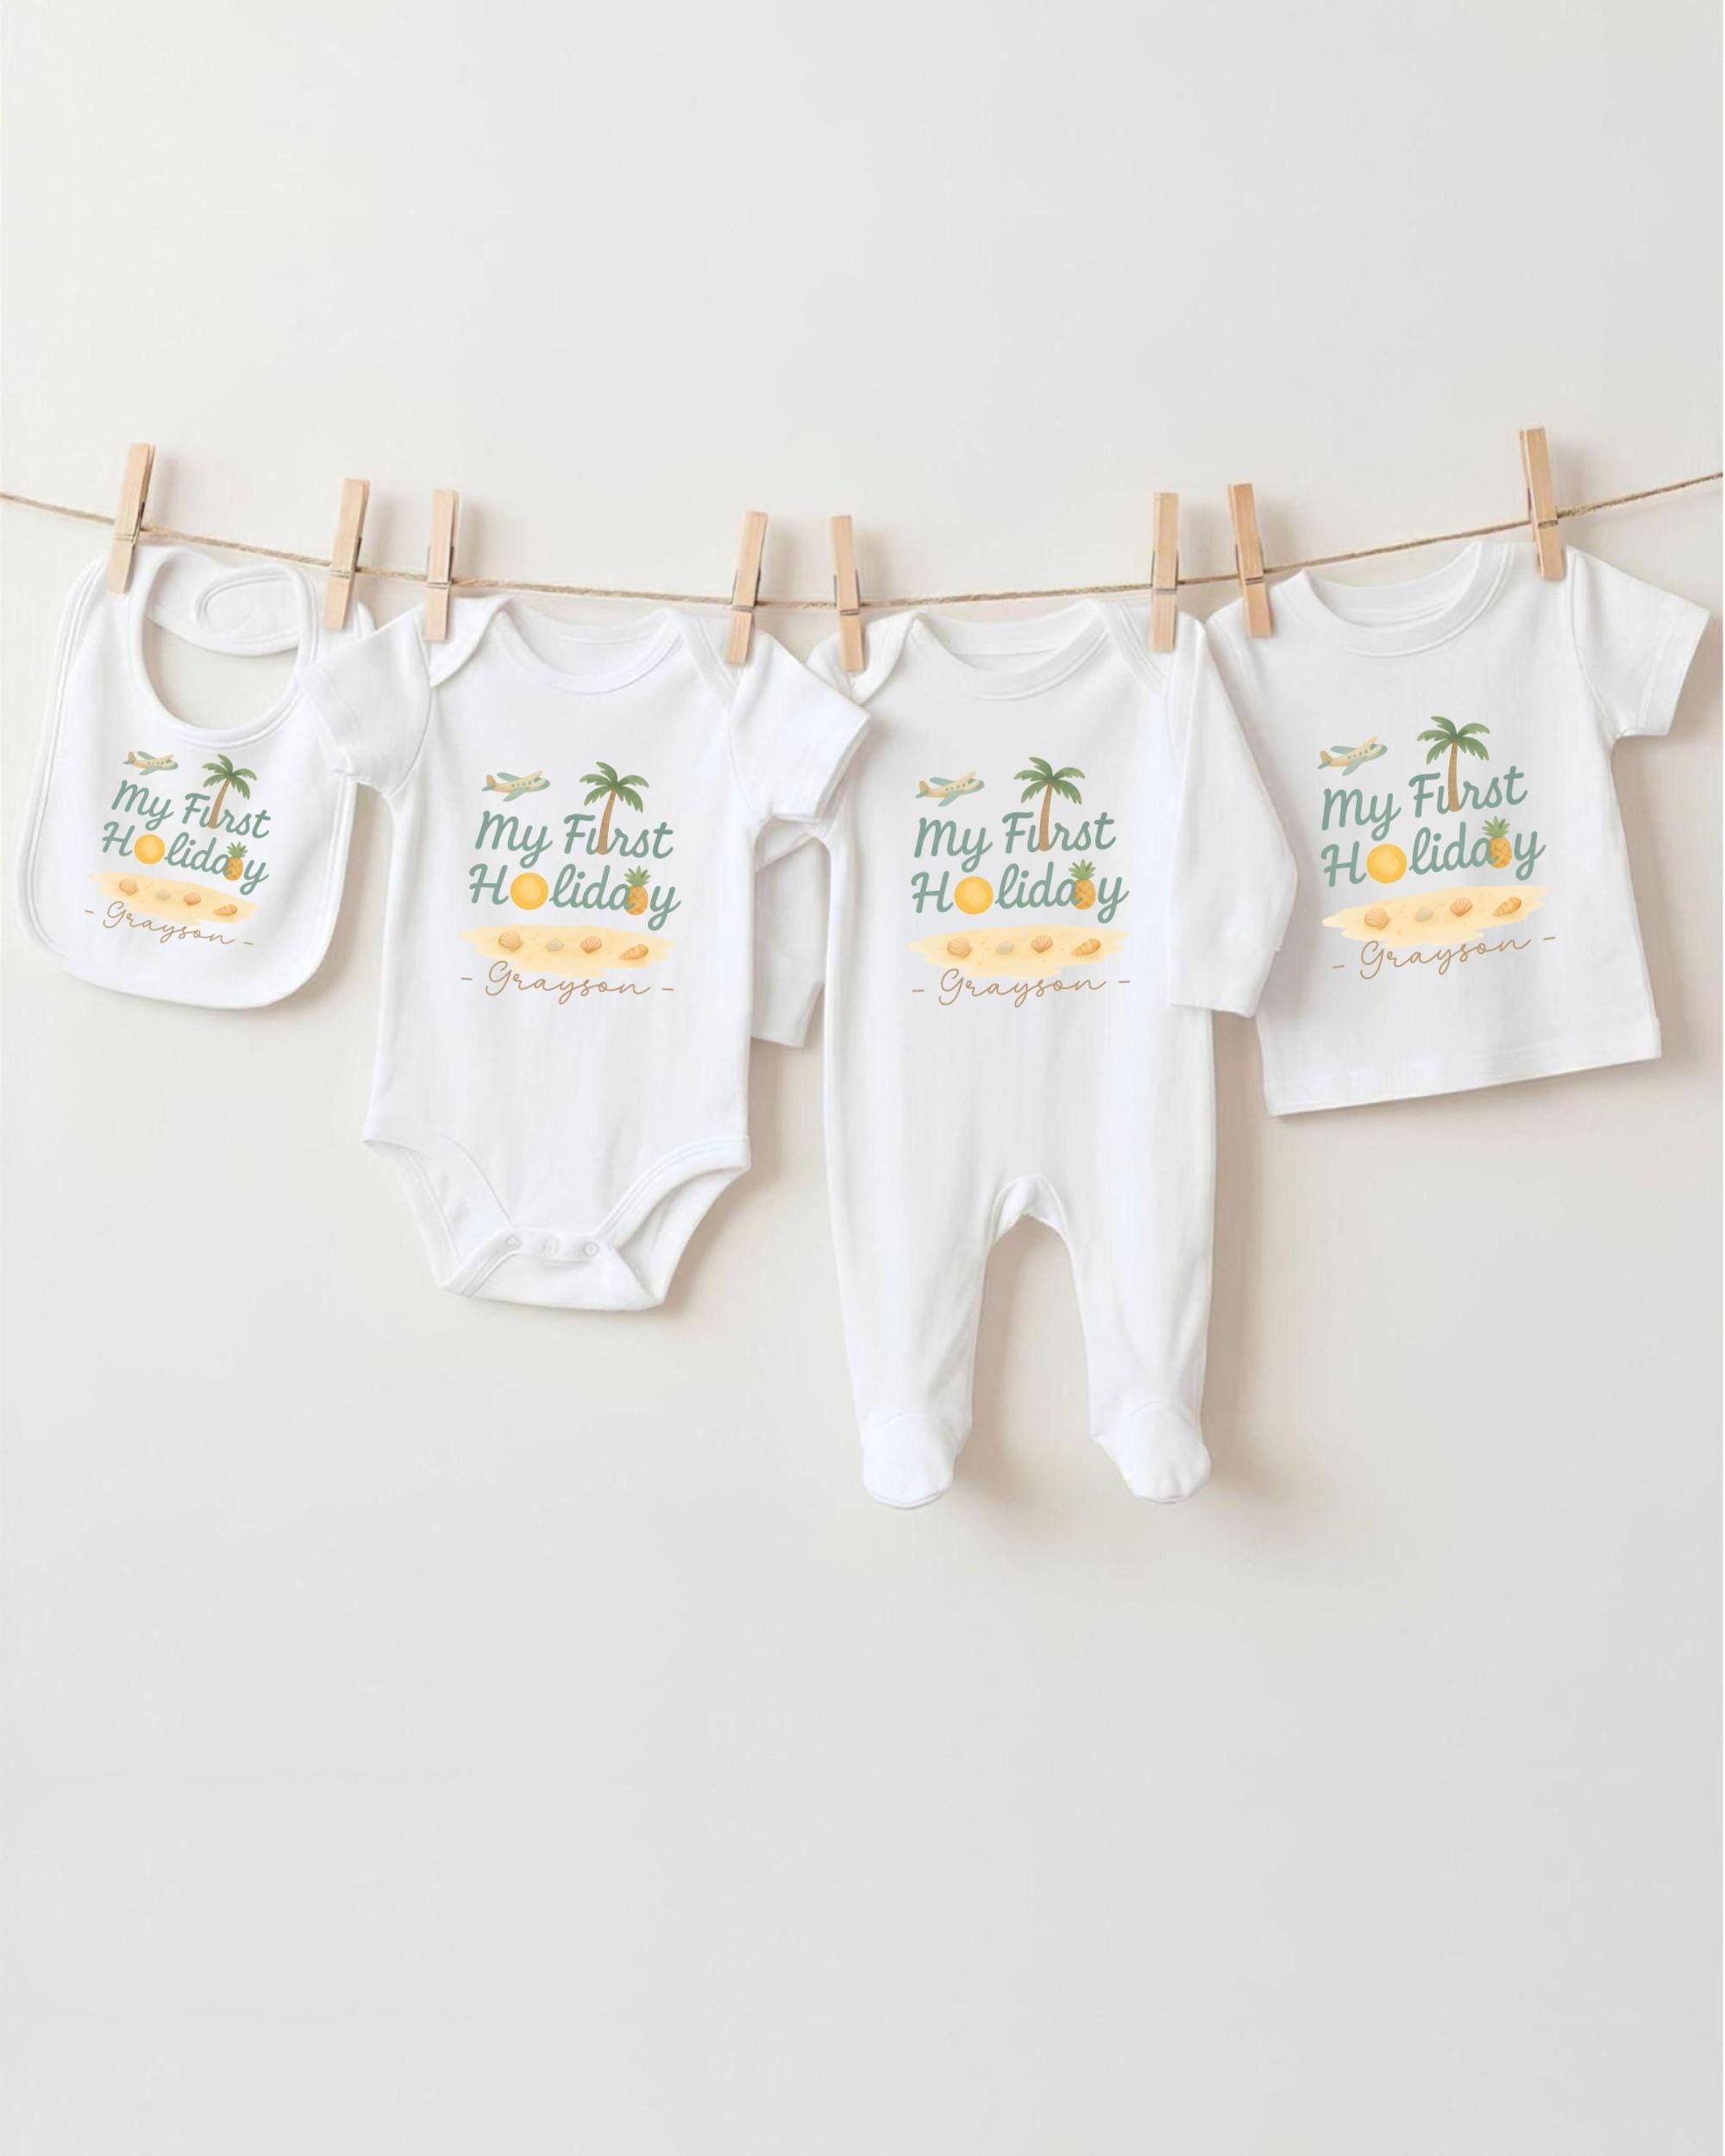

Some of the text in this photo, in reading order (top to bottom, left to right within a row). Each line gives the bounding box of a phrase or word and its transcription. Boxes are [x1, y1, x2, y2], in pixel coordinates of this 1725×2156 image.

[110, 780, 272, 839] My First
[1320, 765, 1527, 842] My First
[474, 810, 674, 869] My First
[913, 812, 1116, 873] My First
[103, 900, 235, 943] Grayson
[485, 960, 651, 1005] Grayson
[1359, 938, 1532, 980] Grayson
[938, 968, 1107, 1008] Grayson
